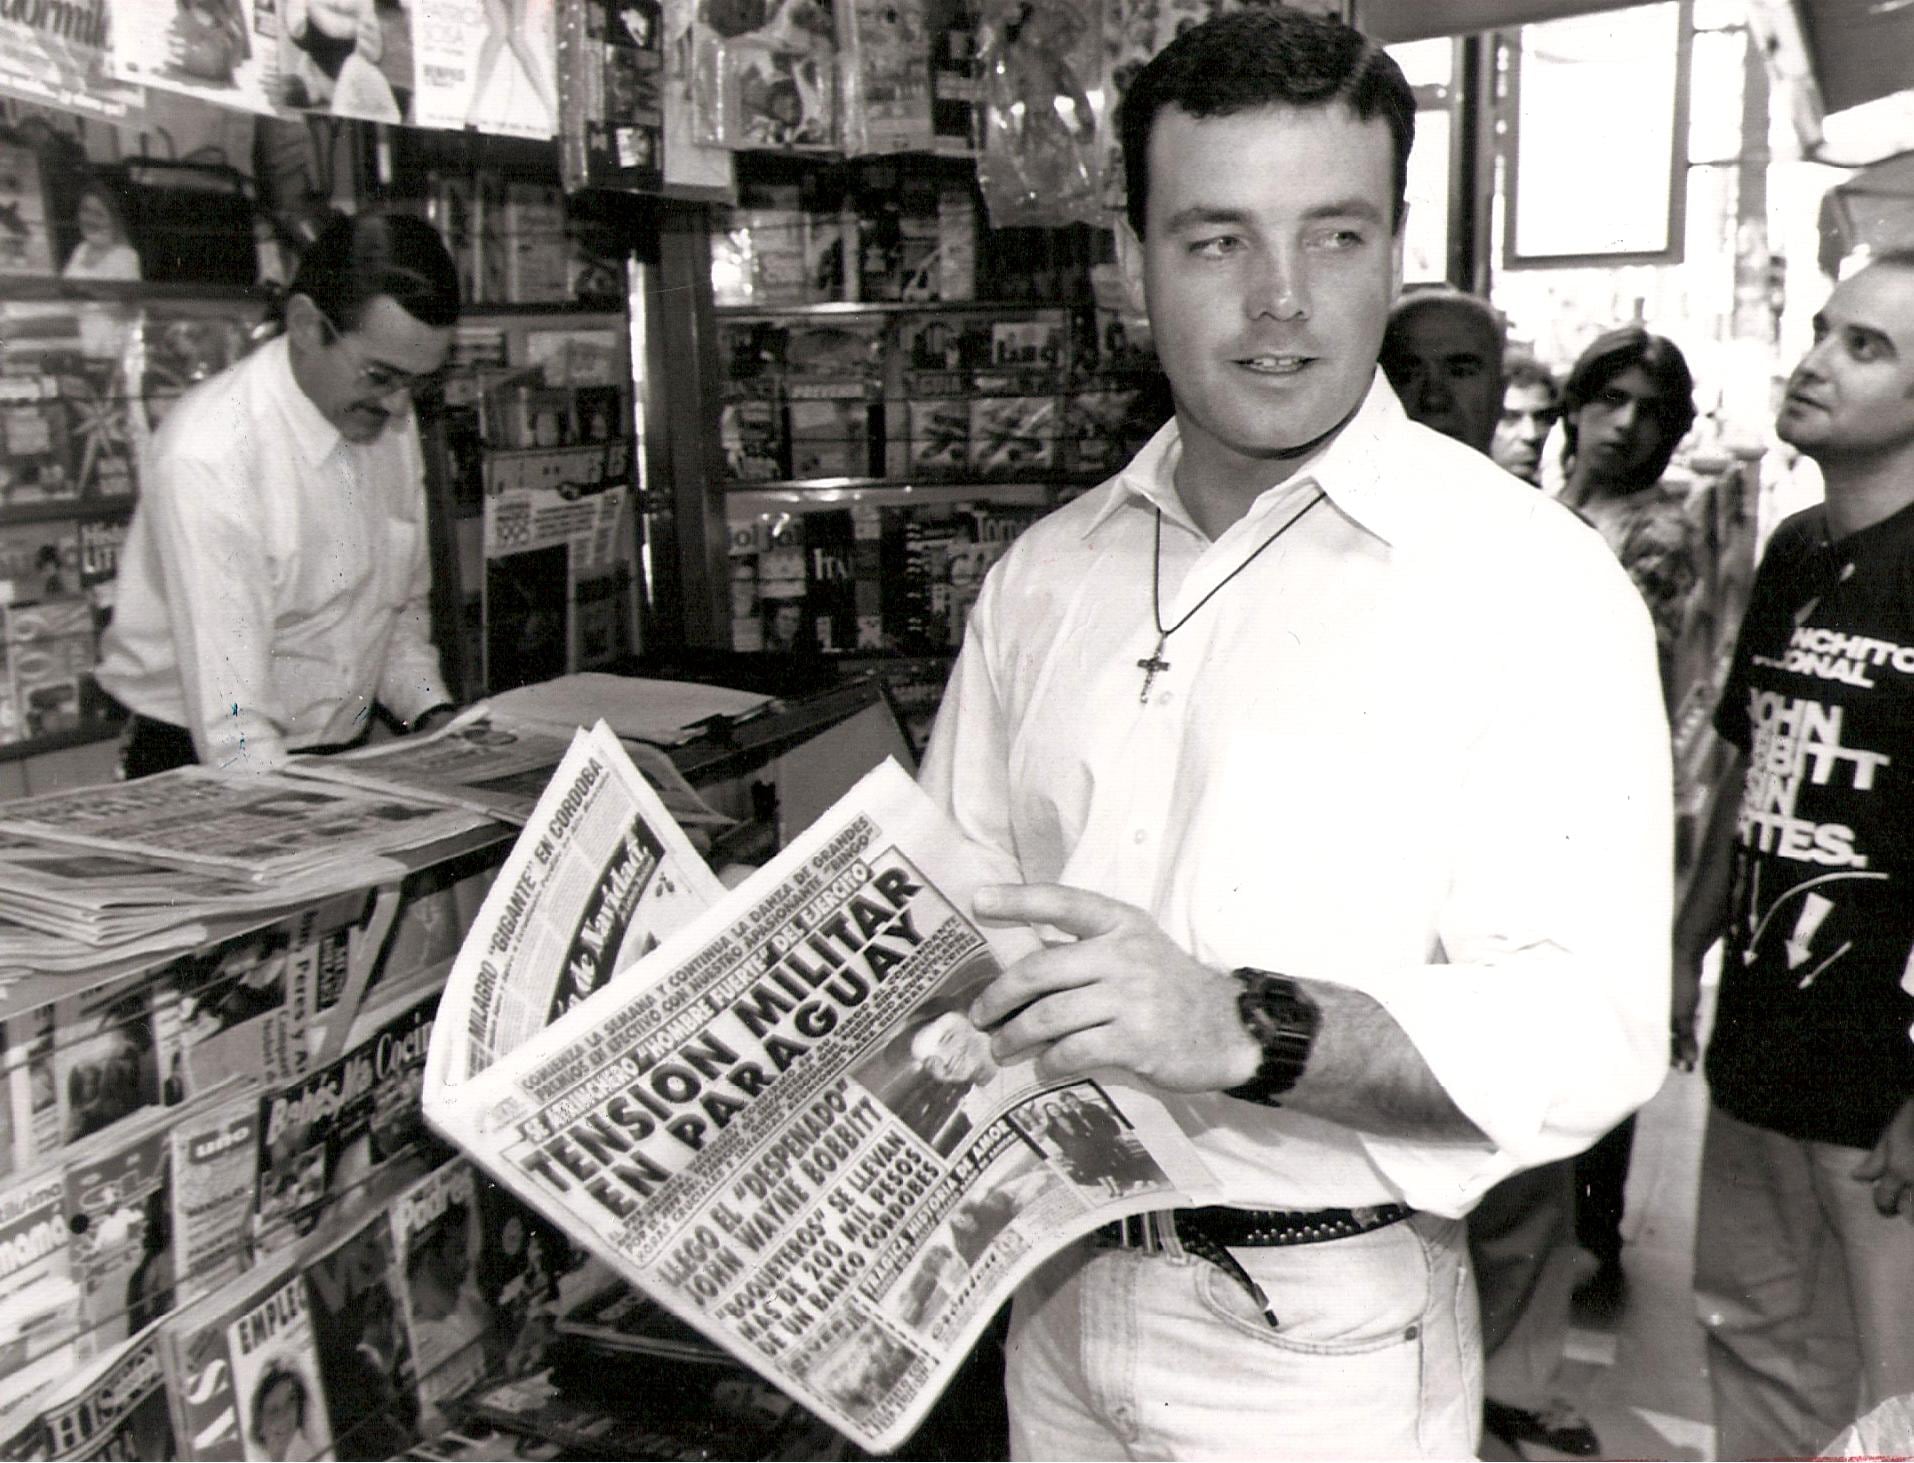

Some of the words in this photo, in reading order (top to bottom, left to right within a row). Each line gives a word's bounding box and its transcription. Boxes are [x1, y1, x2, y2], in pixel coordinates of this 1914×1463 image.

[467, 958, 494, 1043] MILAGRO
[488, 860, 536, 955] "GIGANTE"
[533, 834, 555, 865] EN
[548, 757, 603, 839] CORDOBA
[522, 1043, 585, 1090] COMIENZA
[584, 1031, 604, 1048] LA
[602, 992, 657, 1035] SEMANA
[656, 982, 669, 996] Y
[667, 932, 732, 987] CONTINUA
[729, 919, 750, 938] LA
[748, 884, 790, 923] DANZA
[792, 865, 812, 885] DE
[811, 815, 869, 869] GRANDES
[522, 1116, 550, 1143] SE
[545, 1055, 640, 1129] ATRINCHERO
[635, 996, 715, 1058] "HOMBRE
[708, 944, 768, 1007] FUERTE"
[770, 917, 805, 953] DEL
[798, 860, 870, 929] EJERCITO
[534, 1060, 591, 1102] PREMIOS
[588, 1048, 607, 1065] EN
[606, 1009, 662, 1053] EFECTIVO
[660, 986, 691, 1013] CON
[689, 944, 743, 991] NUESTRO
[742, 875, 824, 948] APASIONANTE
[822, 827, 874, 873] "BINGO"
[887, 915, 958, 985] COMANDANTE
[942, 934, 978, 967] CRISIS
[522, 1029, 740, 1193] TENSION
[731, 868, 923, 1038] MILITAR
[584, 1149, 673, 1218] EN
[665, 908, 923, 1151] PARAGUAY
[653, 1224, 721, 1290] LLEGO
[707, 1200, 744, 1234] EL
[684, 1245, 744, 1306] JOHN
[734, 1175, 810, 1251] WAYNE
[797, 1095, 882, 1186] BOBBITT
[736, 1303, 783, 1342] MAS
[775, 1275, 807, 1308] DE
[800, 1236, 844, 1281] 200
[836, 1204, 876, 1242] MIL
[867, 1145, 923, 1205] PESOS
[755, 1329, 786, 1357] DE
[777, 1304, 814, 1338] UN
[807, 1249, 867, 1311] BANCO
[858, 1160, 940, 1251] CORDOBES
[826, 1185, 855, 1215] SE
[845, 1129, 906, 1194] LLEVAN
[860, 1235, 909, 1292] TRAGICA
[907, 1176, 958, 1237] HISTORIA
[953, 1155, 974, 1176] DE
[970, 1117, 1011, 1159] AMOR
